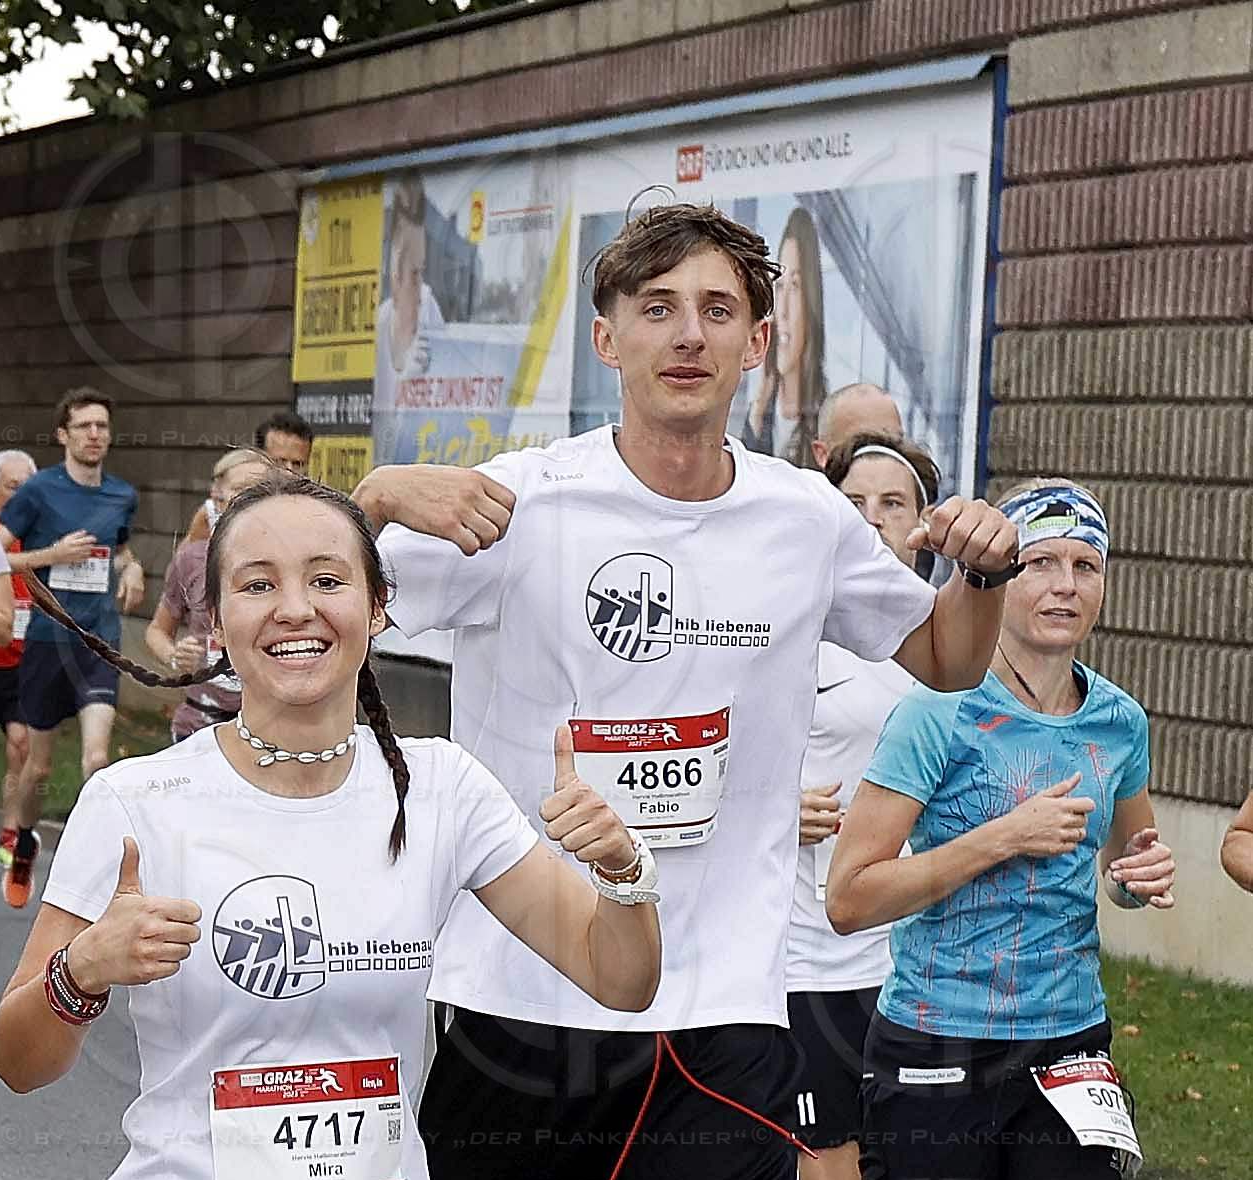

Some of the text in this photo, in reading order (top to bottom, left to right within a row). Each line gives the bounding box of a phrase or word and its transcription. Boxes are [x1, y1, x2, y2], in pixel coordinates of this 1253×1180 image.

[674, 618, 771, 633] hib liebenau
[612, 723, 648, 735] GRAZ
[617, 757, 702, 791] 4866
[639, 801, 680, 814] Fabio
[328, 939, 432, 956] hib liebenau
[263, 1070, 304, 1085] GRAZ
[273, 1110, 365, 1150] 4717
[308, 1162, 344, 1177] Mira
